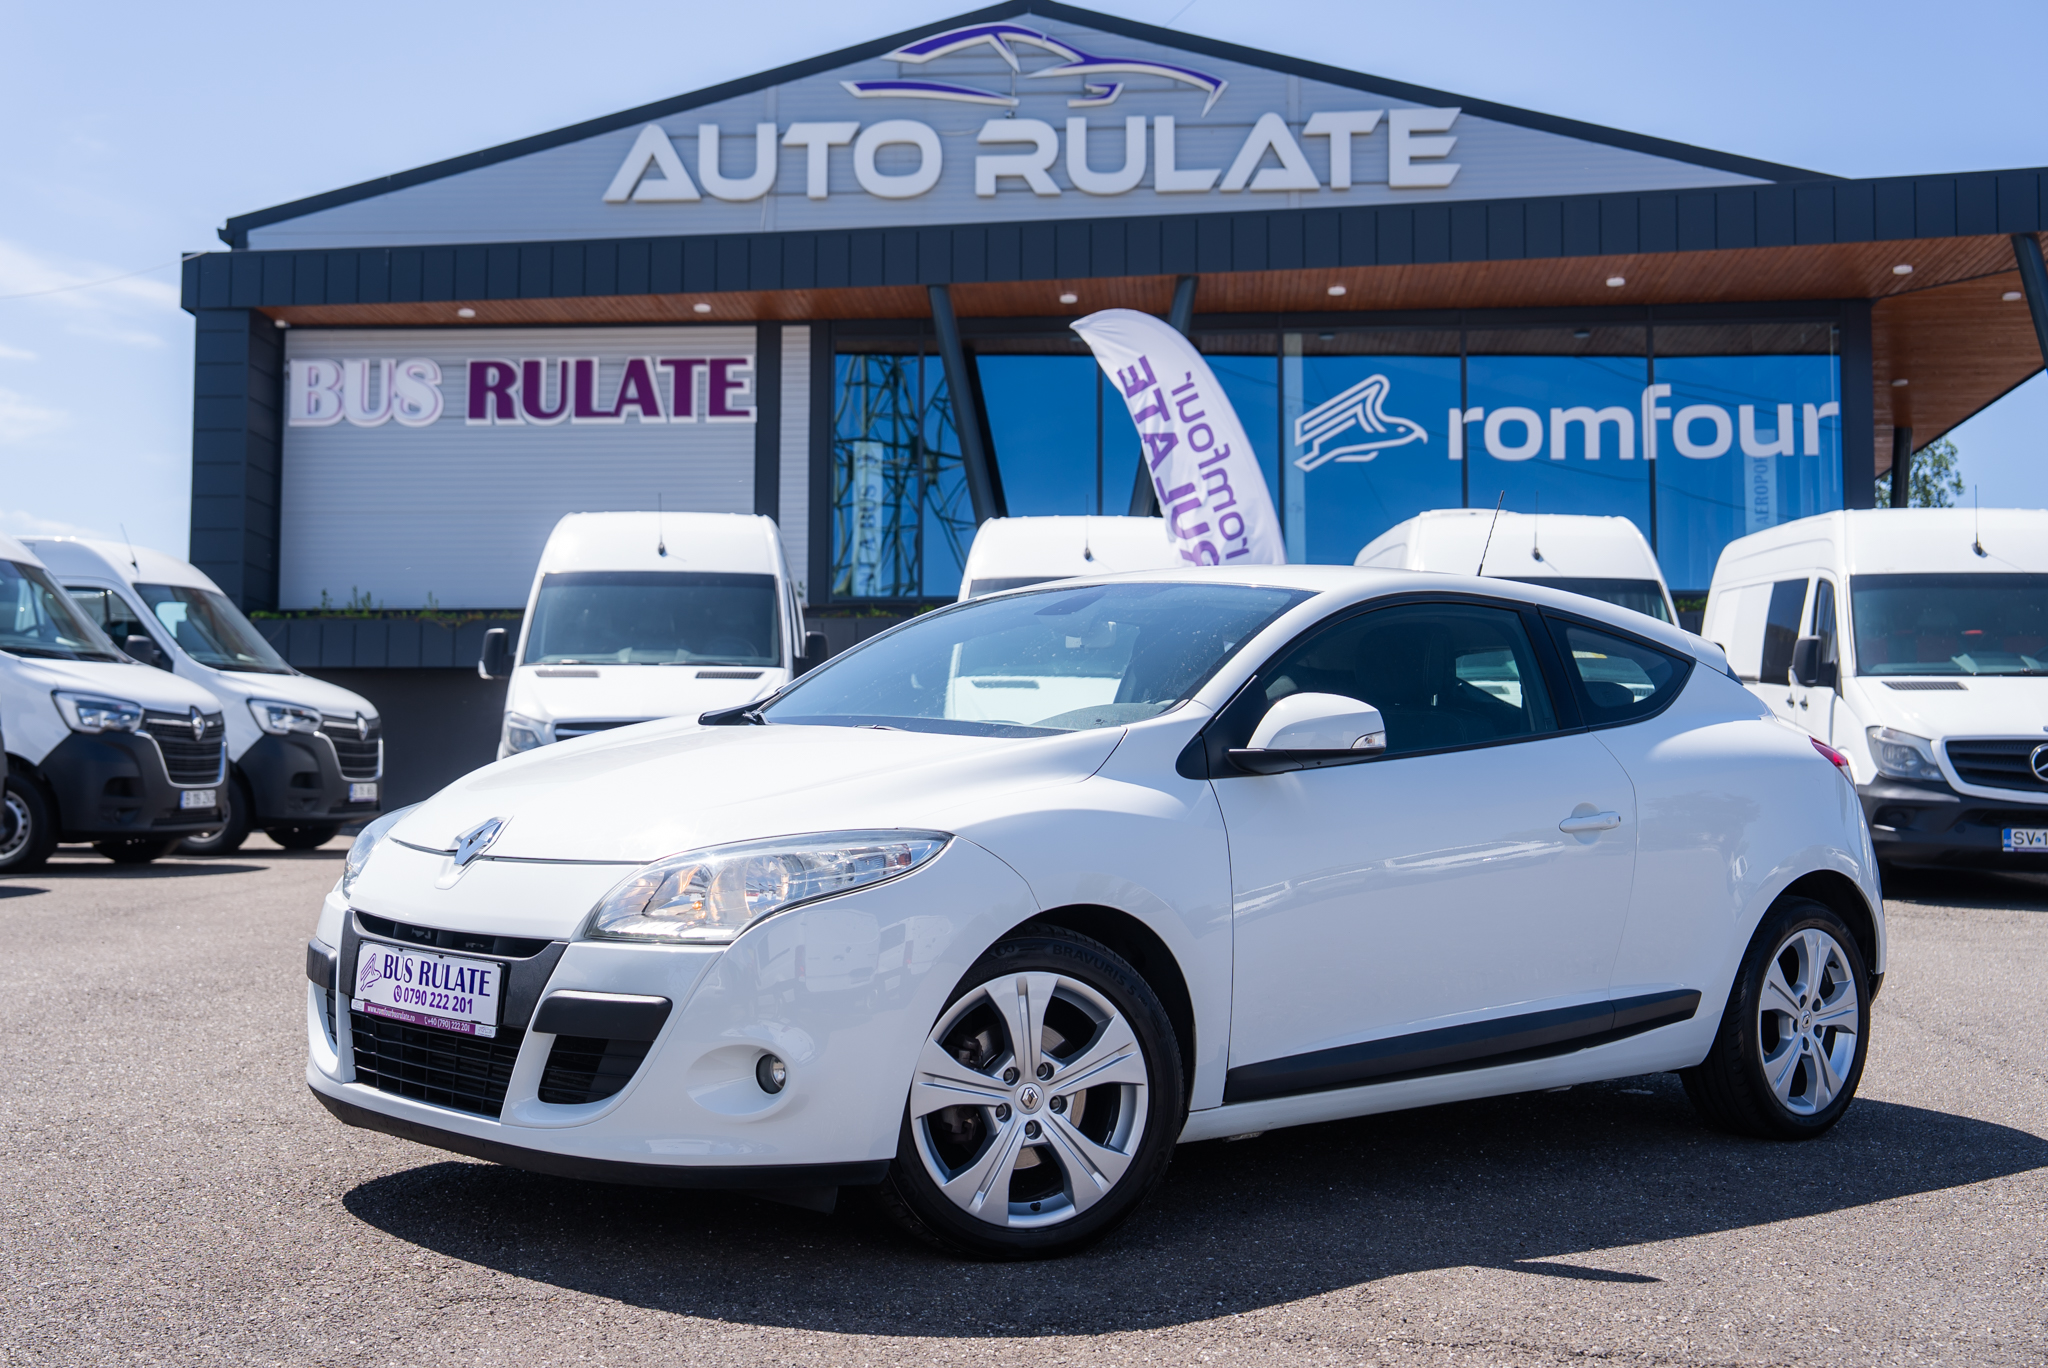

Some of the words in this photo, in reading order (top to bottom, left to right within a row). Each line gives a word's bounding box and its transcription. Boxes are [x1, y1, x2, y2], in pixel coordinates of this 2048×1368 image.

[603, 120, 944, 203] AUTO
[975, 107, 1463, 198] RULATE
[289, 358, 444, 427] BUS
[464, 355, 757, 426] RULATE
[1448, 383, 1840, 462] romfour
[2013, 831, 2036, 846] SV
[384, 954, 413, 983] BUS
[418, 960, 492, 997] RULATE
[1053, 944, 1126, 986] BRAVURIS
[403, 987, 427, 1006] 0790
[429, 992, 449, 1011] 222
[452, 996, 473, 1015] 201
[451, 1021, 461, 1031] 222
